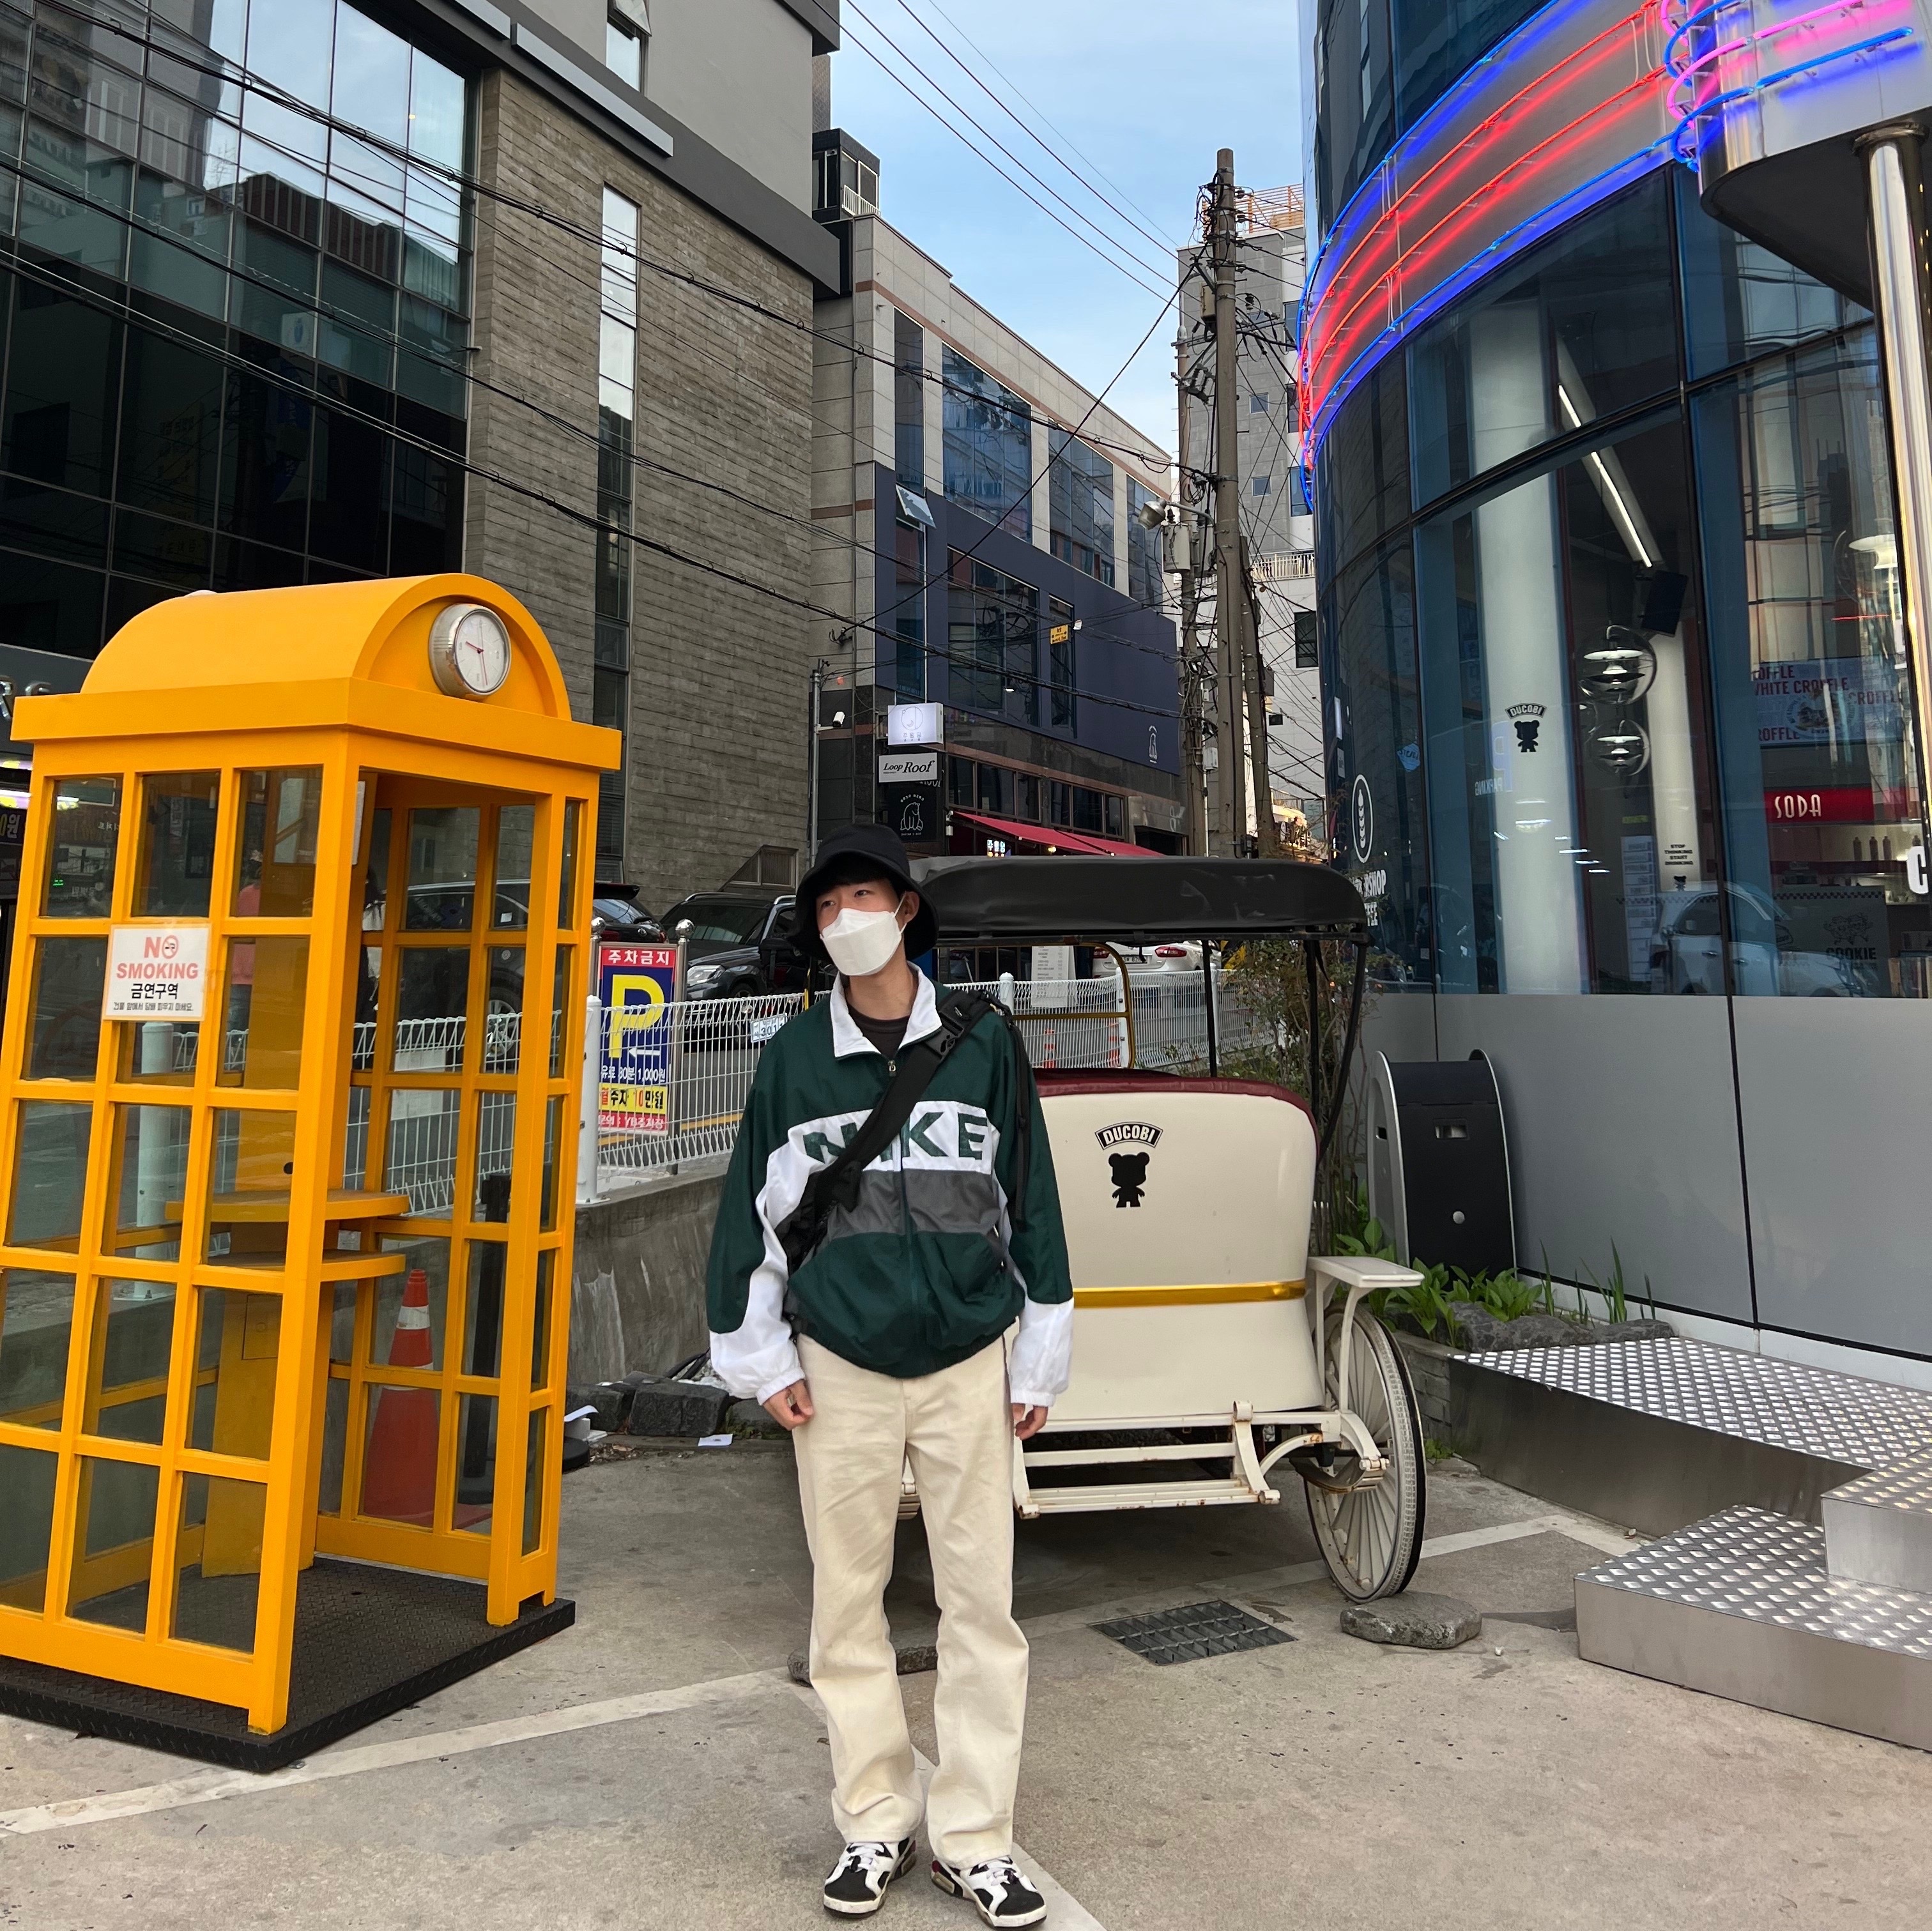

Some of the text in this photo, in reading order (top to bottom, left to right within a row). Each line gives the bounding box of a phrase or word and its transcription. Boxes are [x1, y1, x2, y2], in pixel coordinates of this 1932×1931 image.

[1509, 704, 1543, 717] DUCOBI
[884, 760, 935, 774] Loop Roof
[1775, 794, 1821, 818] SODA
[144, 935, 179, 959] NO
[608, 949, 670, 966] 주차금지
[116, 962, 199, 980] SMOKING
[131, 982, 179, 1000] 금연구역
[608, 974, 665, 1058] P
[802, 1111, 988, 1164] NKE
[1102, 1124, 1156, 1145] DUCOBI
